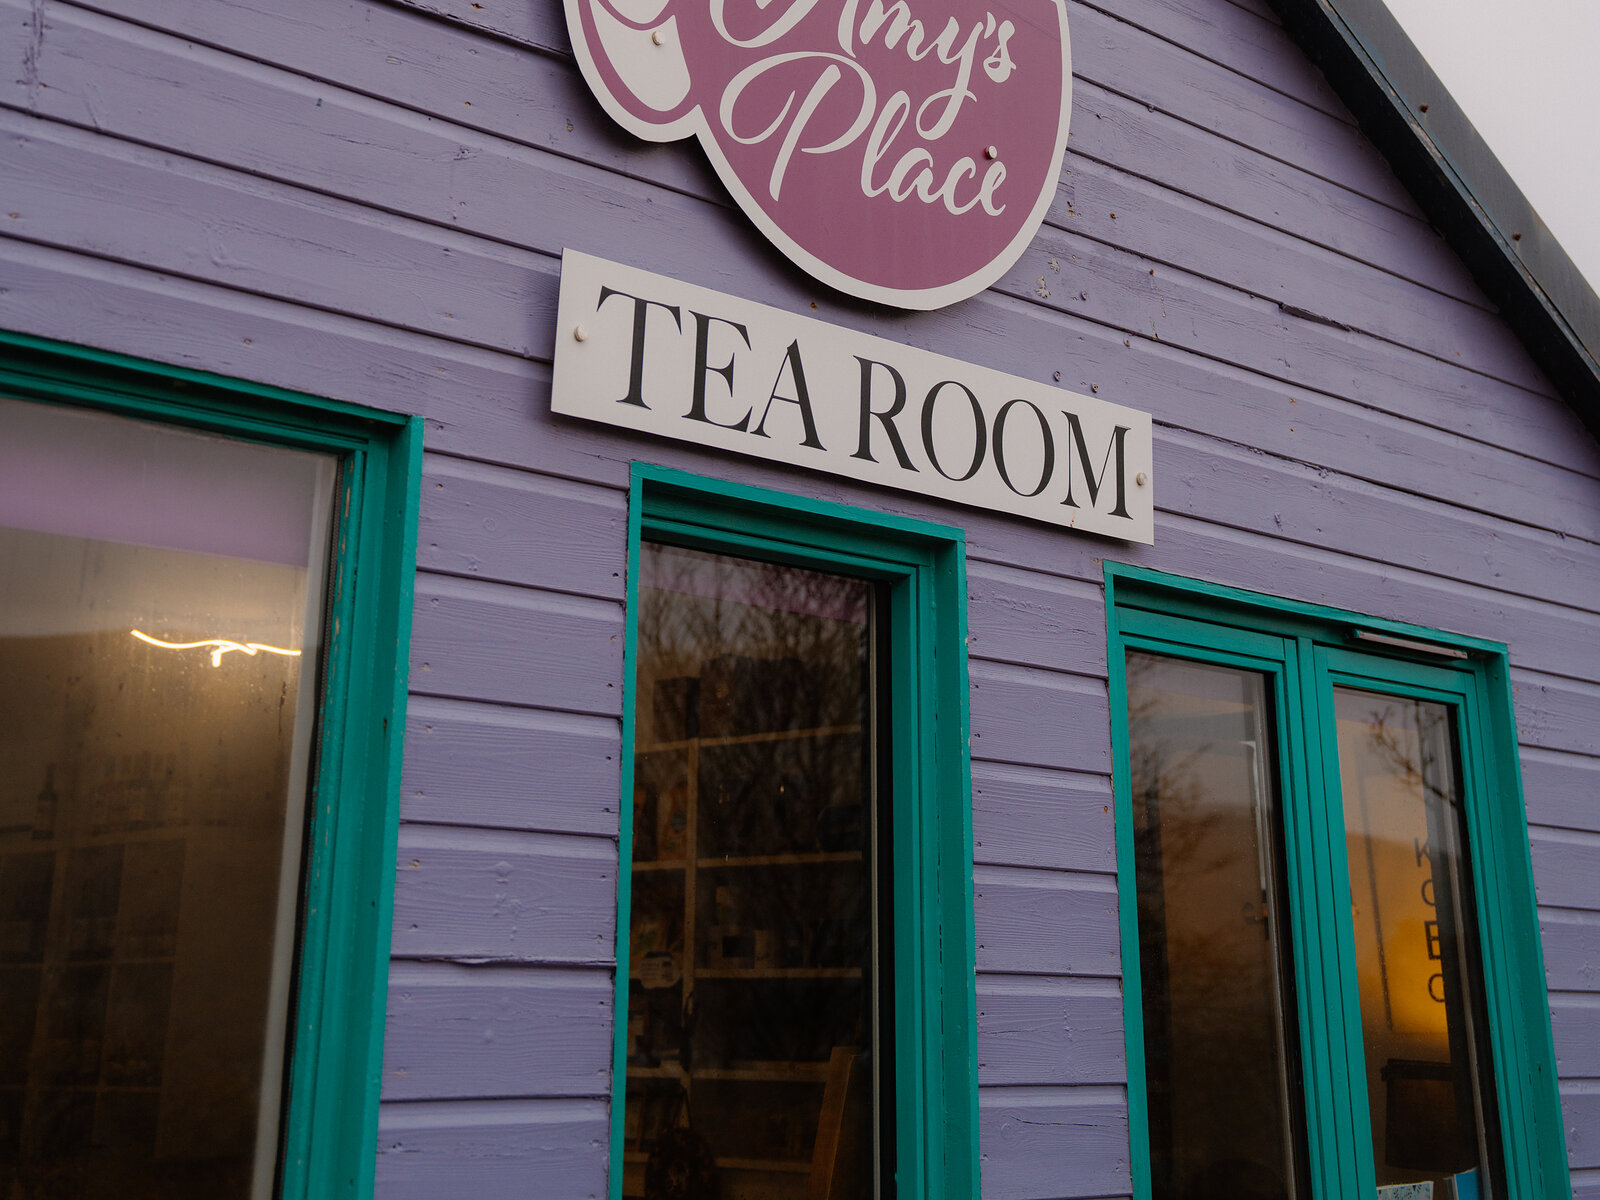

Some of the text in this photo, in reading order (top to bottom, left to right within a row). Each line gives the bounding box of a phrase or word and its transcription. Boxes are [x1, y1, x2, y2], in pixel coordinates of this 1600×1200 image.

[719, 51, 1008, 217] Place
[596, 285, 1135, 521] TEA ROOM
